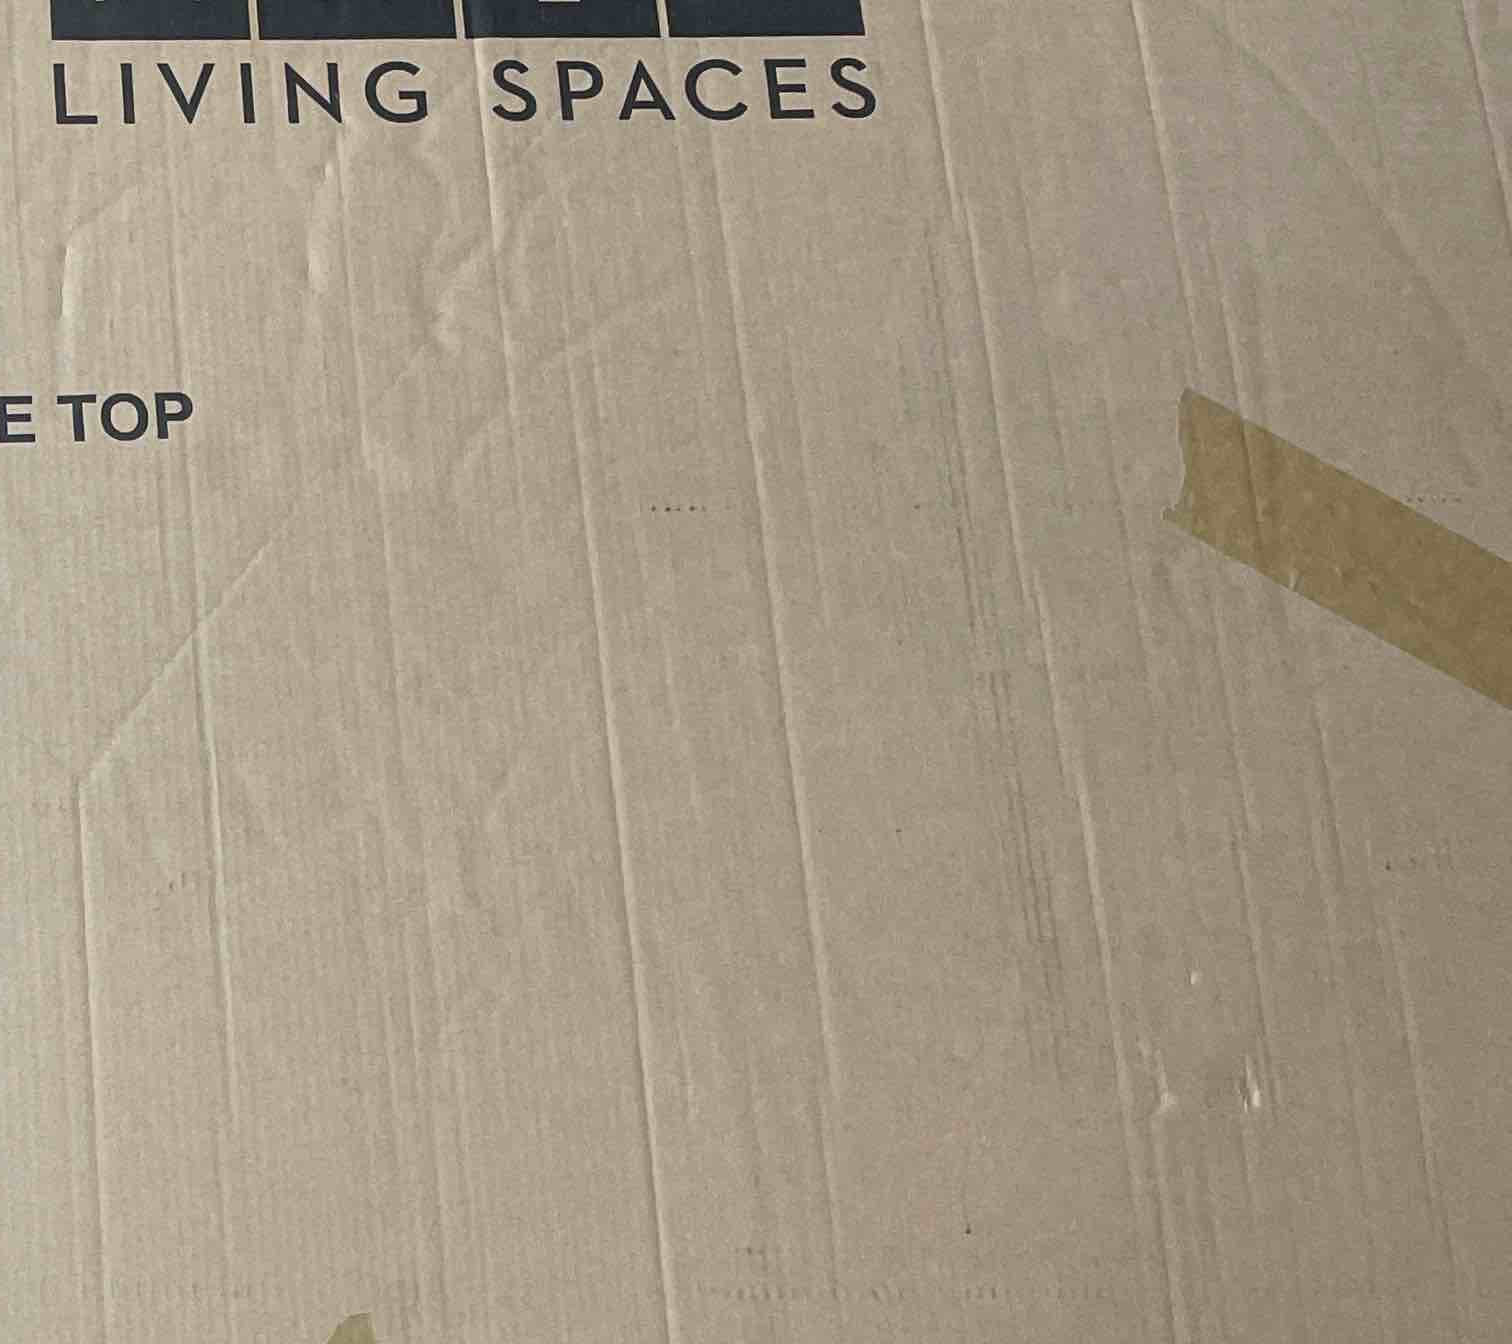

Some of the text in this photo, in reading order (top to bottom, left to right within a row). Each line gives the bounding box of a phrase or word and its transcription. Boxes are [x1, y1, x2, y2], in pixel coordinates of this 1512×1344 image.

[53, 56, 878, 127] LIVING SPACES
[57, 392, 194, 442] TOP
